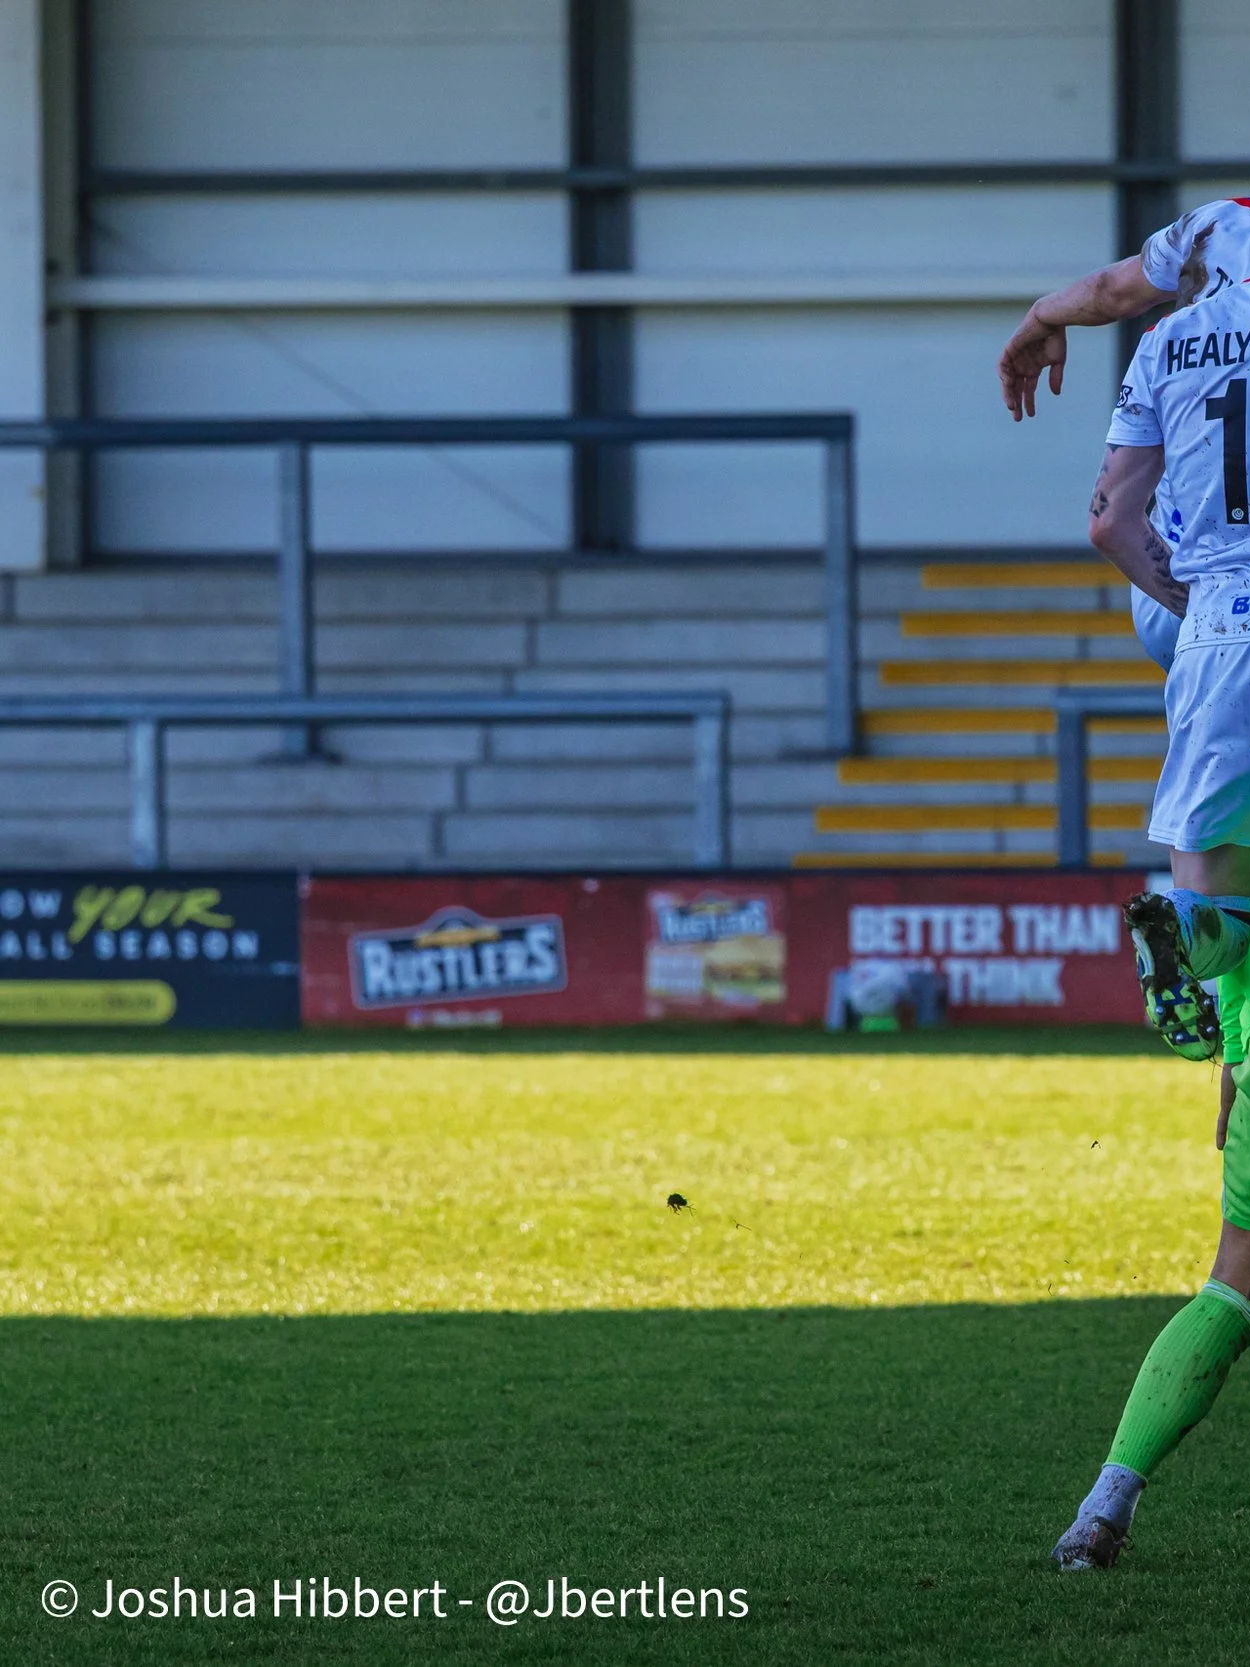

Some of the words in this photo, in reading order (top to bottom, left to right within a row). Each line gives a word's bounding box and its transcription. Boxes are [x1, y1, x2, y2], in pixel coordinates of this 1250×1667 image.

[66, 885, 235, 944] YOUR
[850, 904, 1000, 954] BETTER
[1007, 904, 1121, 954] THAN
[94, 929, 259, 960] SEASON
[358, 925, 558, 998] RUSTLERS
[944, 957, 1065, 1006] THINK
